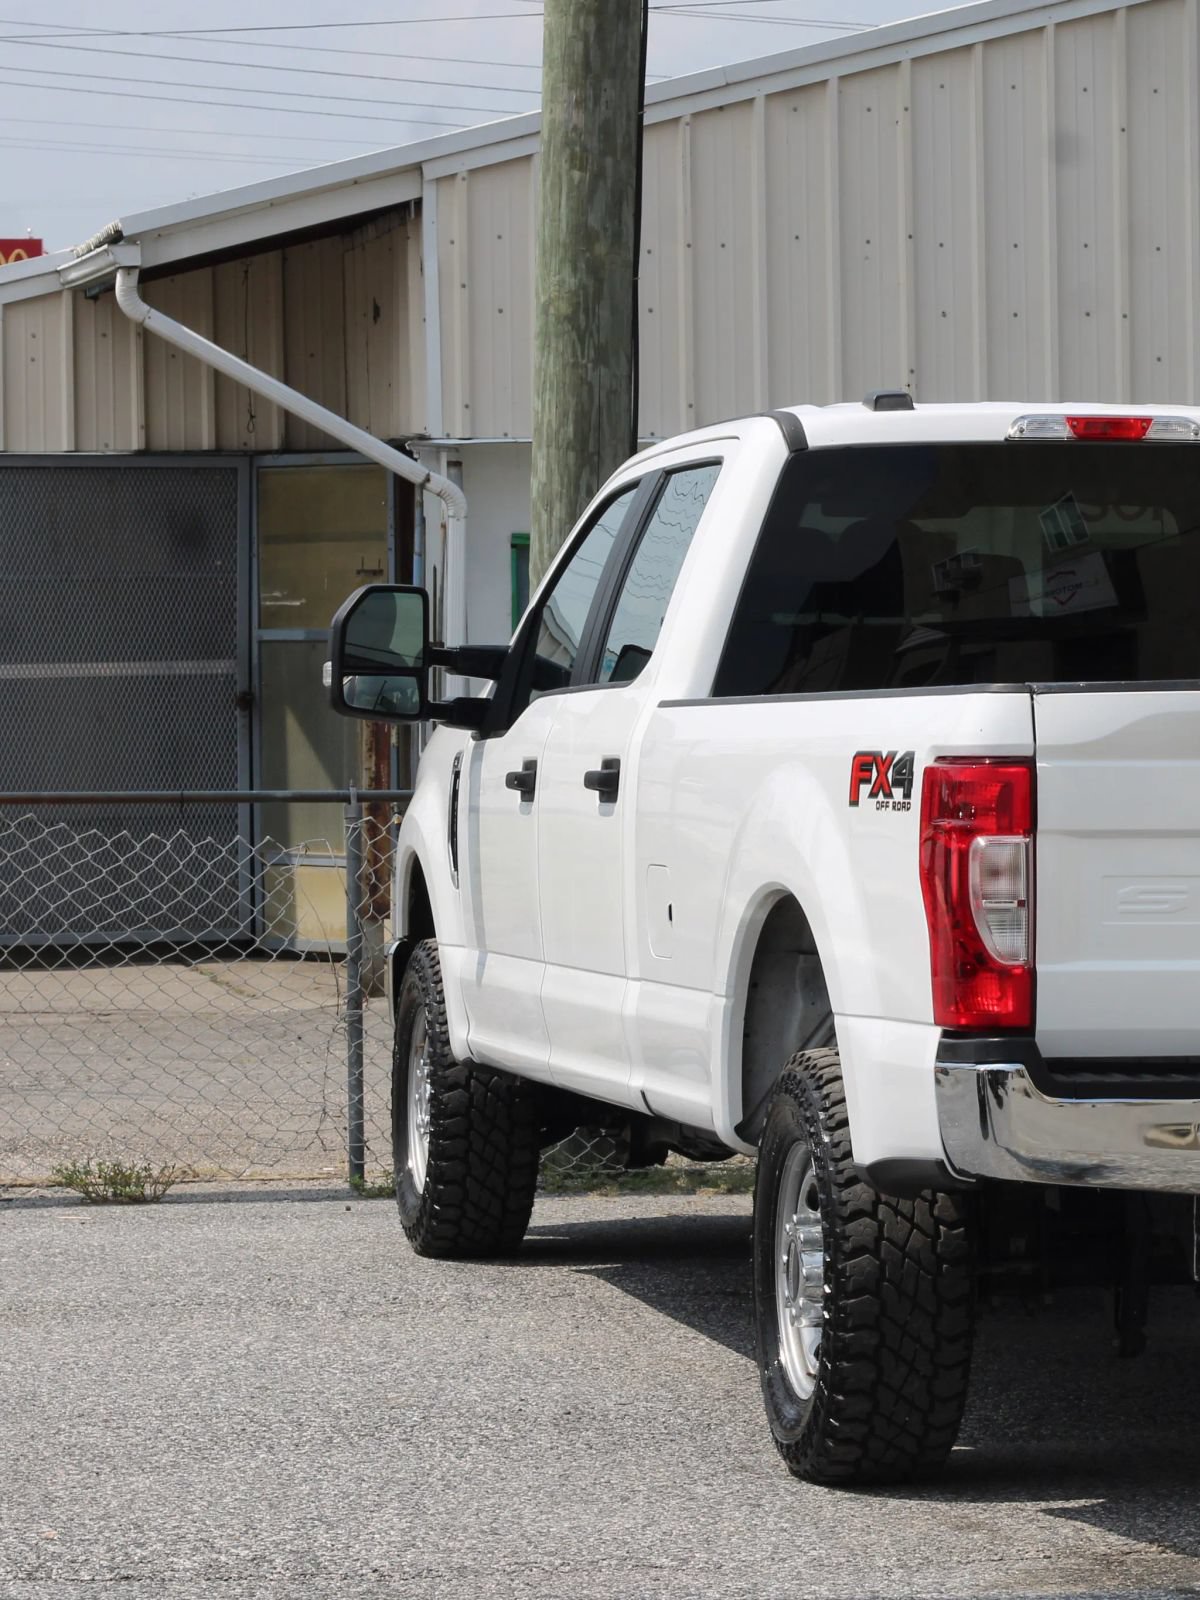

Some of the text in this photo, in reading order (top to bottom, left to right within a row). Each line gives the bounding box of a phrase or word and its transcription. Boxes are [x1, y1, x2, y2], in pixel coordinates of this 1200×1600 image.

[849, 751, 915, 807] FX4
[875, 801, 912, 812] OFF ROAD
